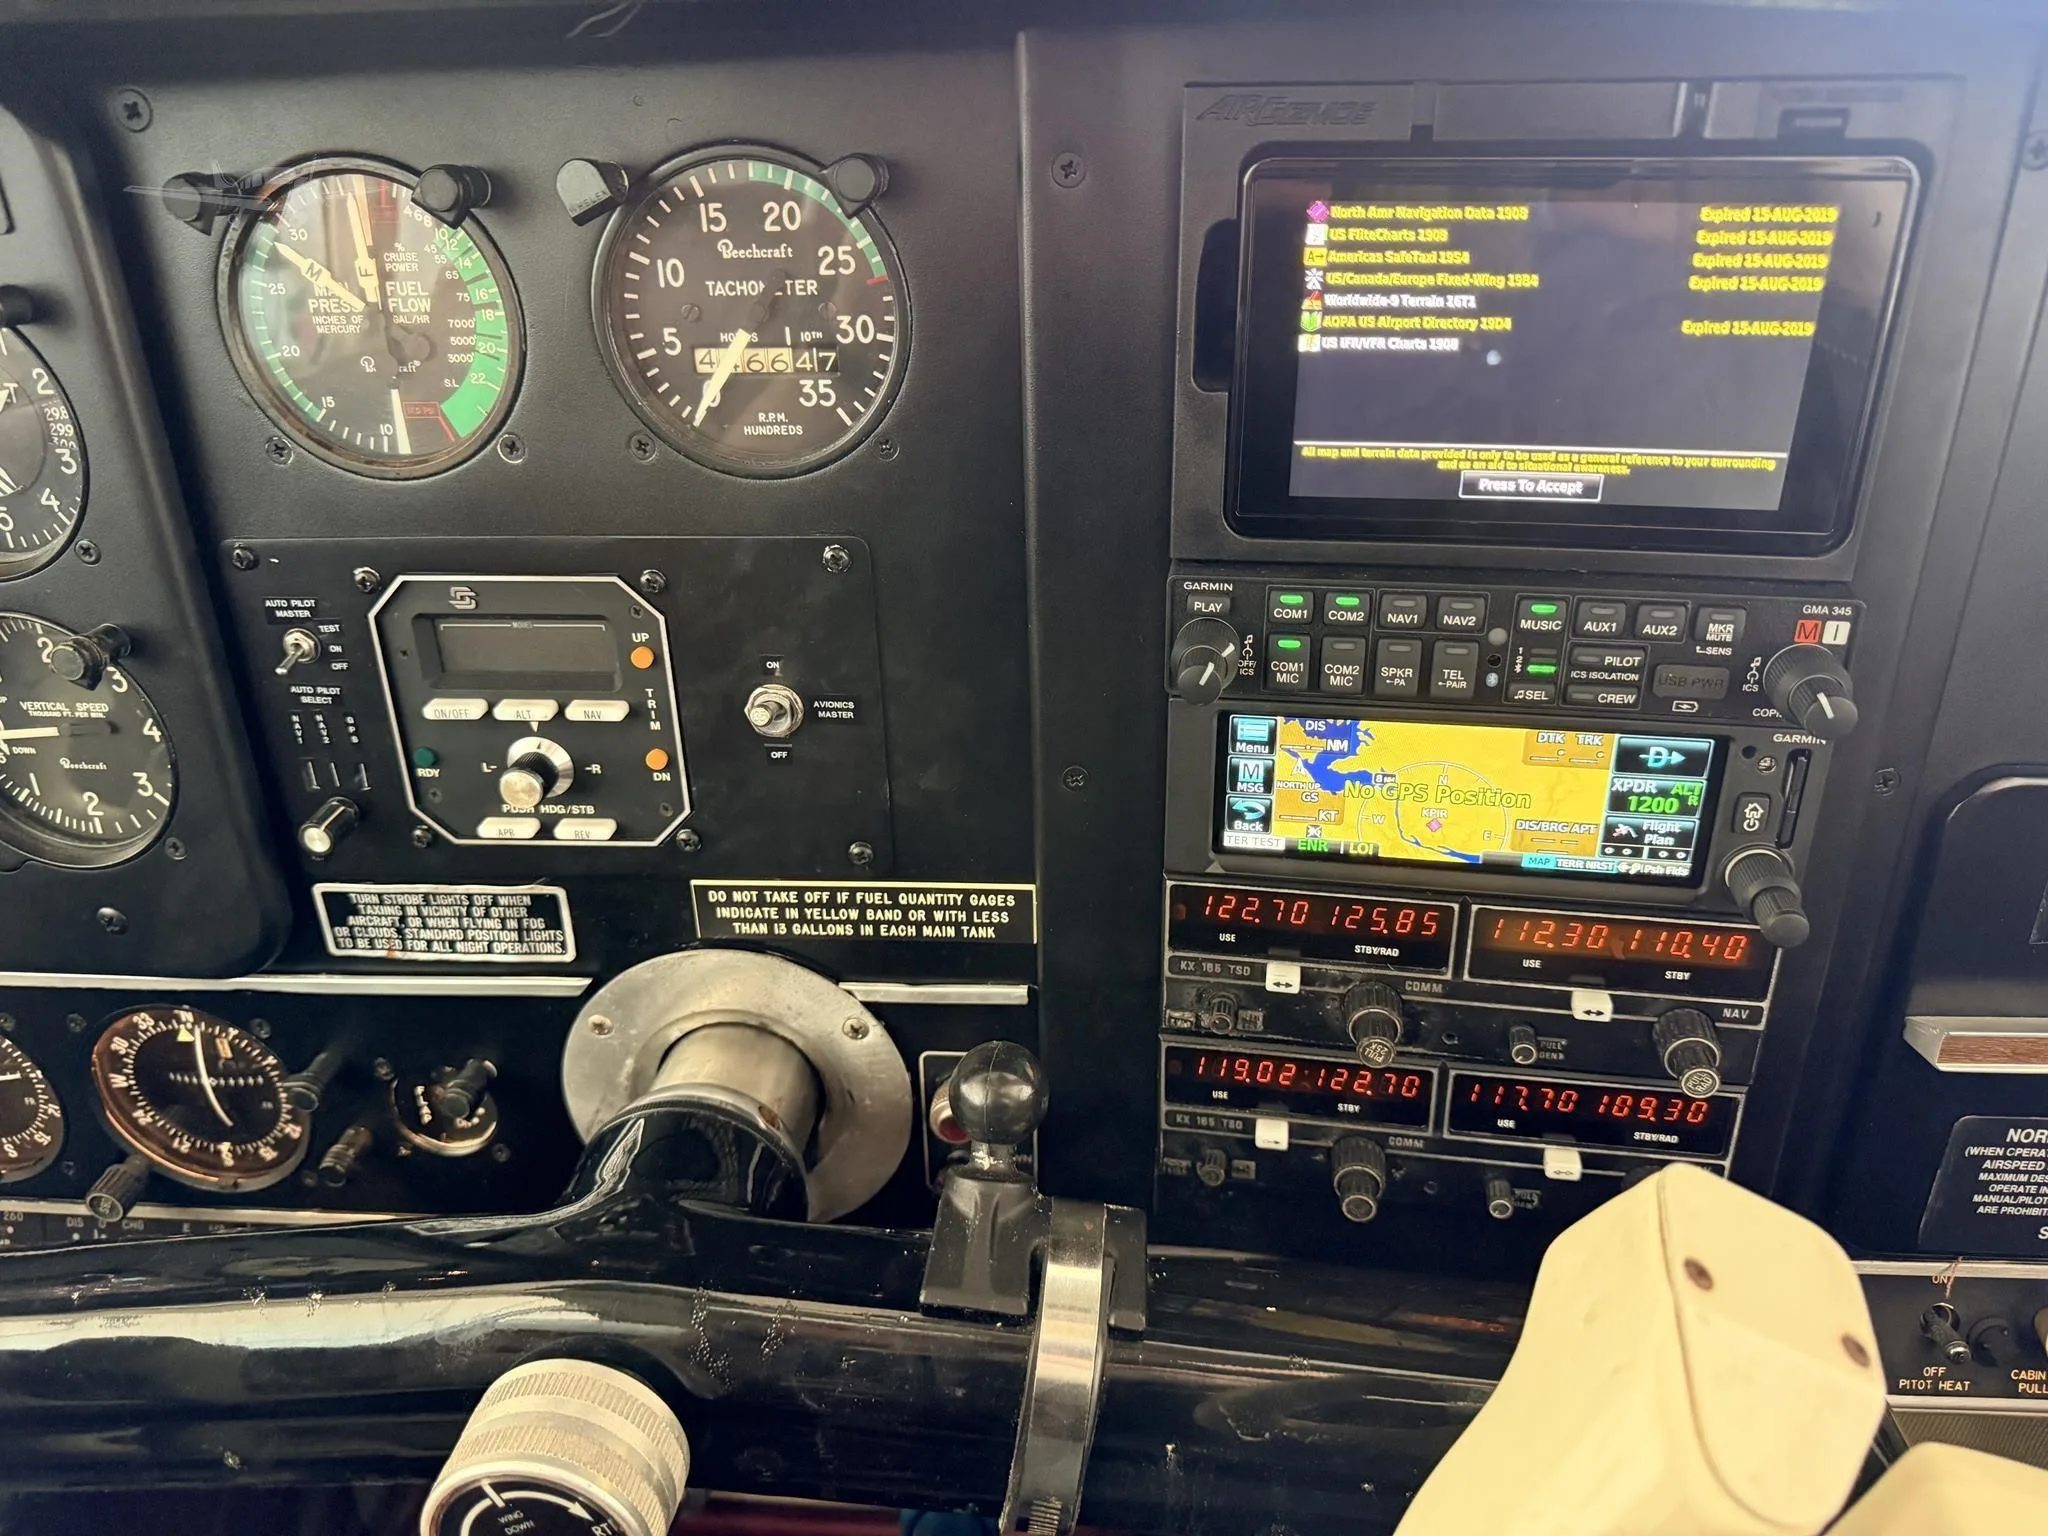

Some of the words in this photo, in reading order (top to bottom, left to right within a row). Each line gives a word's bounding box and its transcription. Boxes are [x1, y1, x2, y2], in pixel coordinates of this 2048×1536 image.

[700, 202, 727, 232] 15
[763, 201, 801, 231] 20
[1330, 206, 1366, 219] North
[1395, 206, 1463, 222] Navigation
[1700, 206, 1751, 224] Expired
[1752, 206, 1839, 223] 15-AUG-2019
[289, 228, 308, 241] 30
[1696, 229, 1747, 247] Expired
[1748, 230, 1834, 246] 15-AUG-2019
[717, 239, 793, 259] Beechcraft
[383, 252, 418, 262] CRUISE
[818, 246, 856, 275] 25
[385, 262, 419, 272] POWER
[445, 271, 459, 279] 65
[657, 258, 685, 288] 10
[268, 283, 286, 295] 25
[385, 281, 429, 296] FUEL
[475, 288, 488, 300] 16
[456, 293, 470, 302] 75
[388, 298, 431, 313] FLOW
[312, 315, 347, 325] INCHES
[352, 315, 364, 324] OF
[393, 315, 430, 324] GAL/HR
[481, 309, 495, 321] 18
[316, 325, 361, 334] MERCURY
[836, 314, 875, 343] 30
[1681, 319, 1731, 336] Expired
[662, 327, 682, 356] 5
[281, 345, 300, 357] 20
[31, 367, 55, 395] 2
[799, 379, 836, 407] 35
[322, 396, 336, 408] 15
[744, 425, 803, 435] HUNDREDS
[55, 448, 77, 475] 3
[1478, 477, 1516, 492] Press
[1518, 479, 1535, 492] To
[1536, 479, 1584, 495] Accept
[40, 487, 61, 512] 4
[1183, 582, 1233, 592] GARMIN
[1194, 602, 1222, 613] PLAY
[1802, 605, 1829, 615] GMA
[1831, 606, 1852, 616] 345
[275, 610, 312, 618] MASTER
[1273, 608, 1308, 619] COM1
[1328, 610, 1365, 621] COM2
[1387, 613, 1418, 624] NAV1
[1443, 615, 1476, 626] NAV2
[1520, 619, 1562, 631] MUSIC
[318, 625, 340, 633] TEST
[1583, 622, 1617, 632] AUX1
[1643, 625, 1678, 636] AUX2
[1708, 623, 1734, 634] MKR
[632, 633, 649, 643] UP
[1706, 633, 1733, 642] MUTE
[331, 662, 349, 670] OFF
[766, 661, 780, 669] ON
[1270, 661, 1304, 672] COM1
[1604, 656, 1642, 667] PILOT
[1324, 663, 1360, 675] COM2
[1380, 667, 1413, 678] SPKR
[1443, 669, 1464, 680] TEL
[1276, 672, 1299, 683] MIC
[1329, 675, 1353, 686] MIC
[1570, 671, 1587, 679] ICS
[1588, 671, 1639, 681] ISOLATION
[1598, 694, 1636, 704] CREW
[19, 701, 70, 711] VERTICAL
[76, 702, 109, 712] SPEED
[813, 701, 855, 709] AVIONICS
[583, 710, 602, 720] NAV
[818, 711, 854, 719] MASTER
[143, 718, 162, 743] 4
[1305, 720, 1326, 731] DIS
[1537, 732, 1565, 744] DTK
[1576, 734, 1603, 746] TRK
[1236, 742, 1269, 754] Menu
[1327, 740, 1348, 752] NM
[770, 751, 788, 759] OFF
[416, 768, 440, 778] RDY
[653, 772, 671, 782] DN
[132, 771, 153, 797] 3
[1237, 783, 1264, 793] MSG
[1611, 779, 1658, 794] XPDR
[1670, 783, 1703, 796] ALT
[1301, 791, 1319, 803] GS
[1344, 781, 1375, 800] No
[1381, 783, 1429, 802] GPS
[1435, 785, 1532, 809] Position
[540, 804, 595, 815] HDG/STB
[1628, 795, 1680, 814] 1200
[1318, 810, 1339, 822] KT
[1421, 808, 1448, 819] KPIR
[1234, 821, 1263, 832] Back
[1642, 821, 1681, 834] Flight
[1298, 839, 1329, 852] ENR
[1644, 834, 1675, 847] Plan
[1528, 857, 1550, 867] MAP
[349, 893, 380, 904] TURN
[383, 894, 426, 905] STROBE
[430, 895, 469, 906] LIGHTS
[473, 895, 493, 905] OFF
[497, 895, 531, 906] WHEN
[707, 890, 727, 903] DO
[732, 890, 758, 903] NOT
[763, 891, 799, 903] TAKE
[804, 891, 831, 903] OFF
[836, 891, 850, 904] IF
[856, 892, 892, 905] FUEL
[898, 893, 963, 906] QUANTITY
[969, 894, 1016, 907] GAGES
[358, 905, 403, 916] TAXIING
[406, 905, 418, 916] IN
[421, 905, 467, 916] VICINITY
[472, 907, 487, 917] OF
[490, 907, 528, 917] OTHER
[716, 907, 779, 919] INDICATE
[785, 907, 799, 919] IN
[804, 908, 859, 920] YELLOW
[866, 909, 902, 921] BAND
[908, 910, 926, 922] OR
[933, 910, 967, 923] WITH
[973, 911, 1010, 924] LESS
[1205, 895, 1309, 925] 122.70
[1331, 905, 1440, 936] 125.85
[732, 922, 768, 934] THAN
[792, 923, 854, 936] GALLONS
[860, 924, 874, 936] IN
[880, 925, 917, 937] EACH
[922, 925, 955, 938] MAIN
[961, 926, 996, 939] TANK
[1219, 933, 1236, 943] USE
[1354, 944, 1399, 957] STBY/RAD
[1522, 959, 1542, 968] USE
[1665, 970, 1690, 981] STBY
[1405, 980, 1443, 993] COMM
[1722, 1007, 1749, 1020] NAV
[132, 1012, 155, 1030] 33
[111, 1036, 129, 1055] 30
[1198, 1056, 1296, 1086] 119.02
[1317, 1068, 1421, 1099] 122.70
[1212, 1090, 1228, 1099] USE
[1337, 1103, 1360, 1113] STBY
[1634, 1131, 1679, 1143] STBY/RAD
[1965, 1146, 2005, 1157] (WHEN
[1982, 1160, 2046, 1171] AIRSPEED
[1978, 1172, 2028, 1182] MAXIMUM
[1988, 1184, 2038, 1194] OPERATE
[1976, 1205, 1999, 1214] ARE
[1923, 1366, 1946, 1377] OFF
[2011, 1369, 2047, 1380] CABIN
[1898, 1379, 1932, 1390] PITOT
[1938, 1380, 1970, 1391] HEAT
[497, 1510, 523, 1525] WING
[504, 1519, 535, 1536] DOWN
